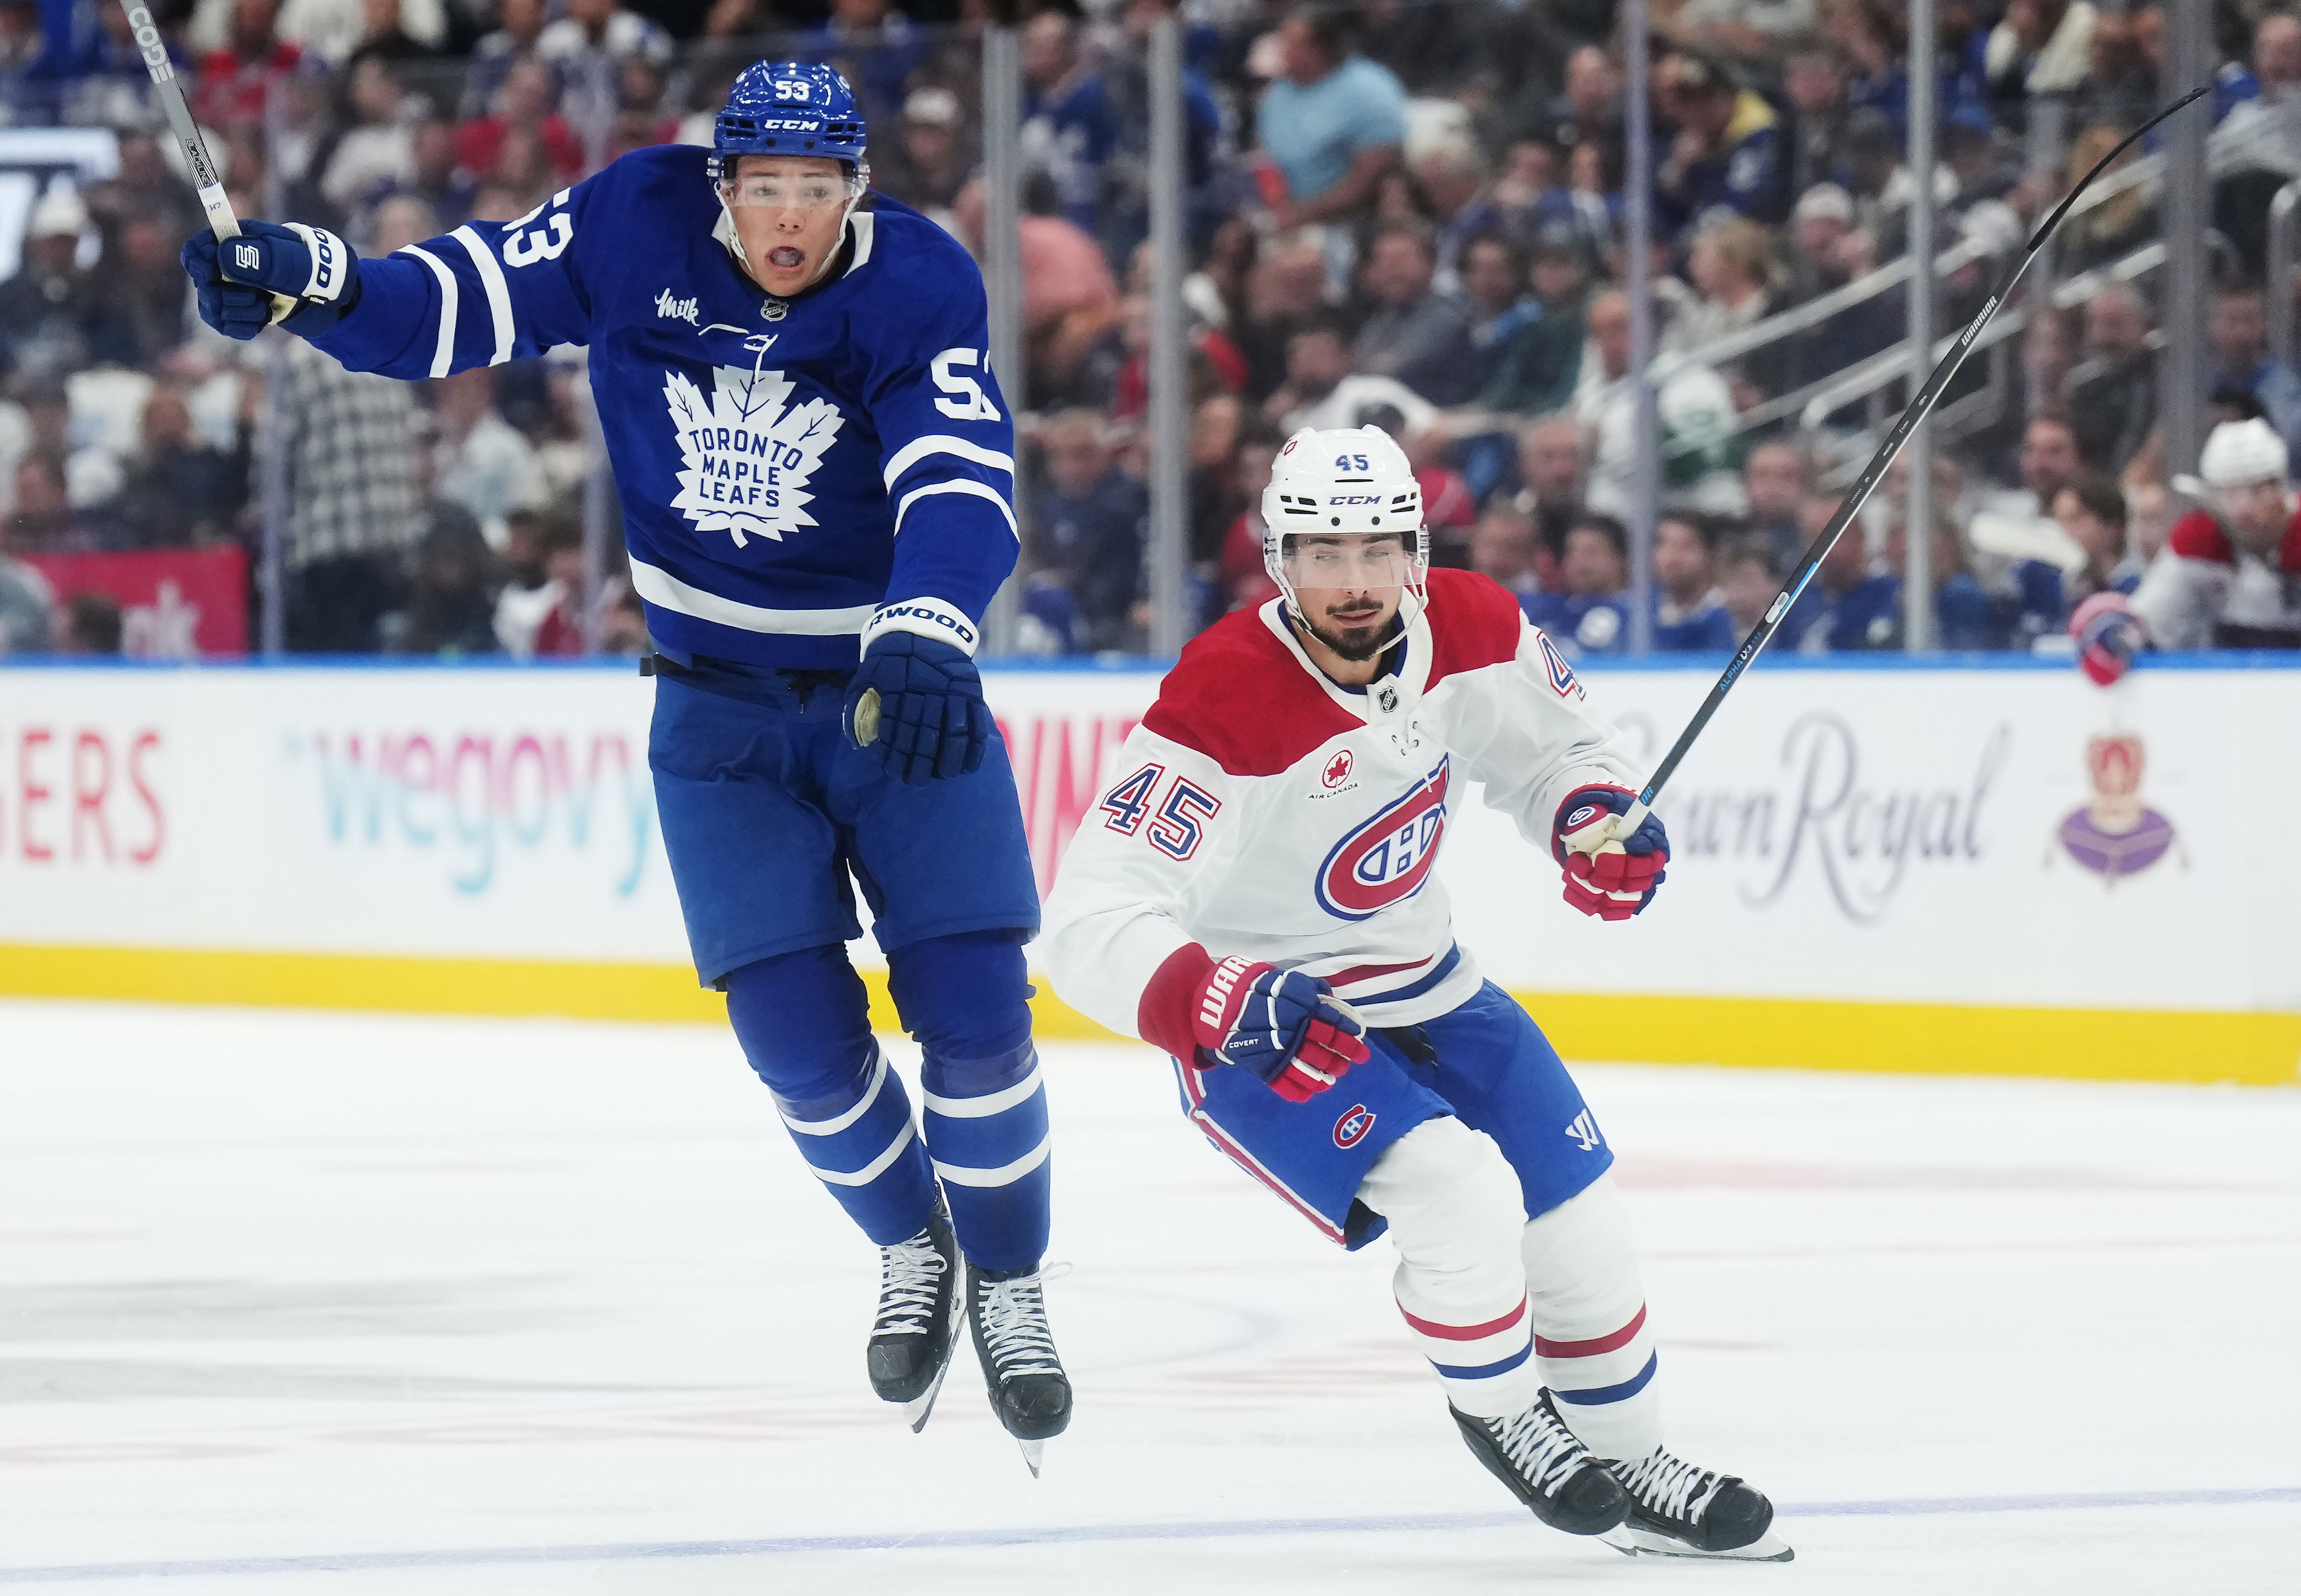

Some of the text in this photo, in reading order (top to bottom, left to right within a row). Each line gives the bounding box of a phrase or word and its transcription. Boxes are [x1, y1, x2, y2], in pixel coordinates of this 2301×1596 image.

[775, 80, 810, 102] 53
[764, 119, 820, 131] CCM
[186, 138, 210, 185] BLACKLINE
[654, 287, 700, 327] Milk
[1961, 296, 1997, 346] WARRIOR
[689, 427, 803, 470] TORONTO
[1335, 455, 1369, 471] 45
[702, 454, 781, 486] MAPLE
[700, 478, 779, 507] LEAFS
[1328, 495, 1382, 505] CCM
[0, 727, 168, 868] ERS
[1327, 783, 1358, 798] CANADA
[311, 730, 653, 897] wegovy
[1099, 763, 1222, 862] 45
[1229, 1038, 1259, 1049] COVERT
